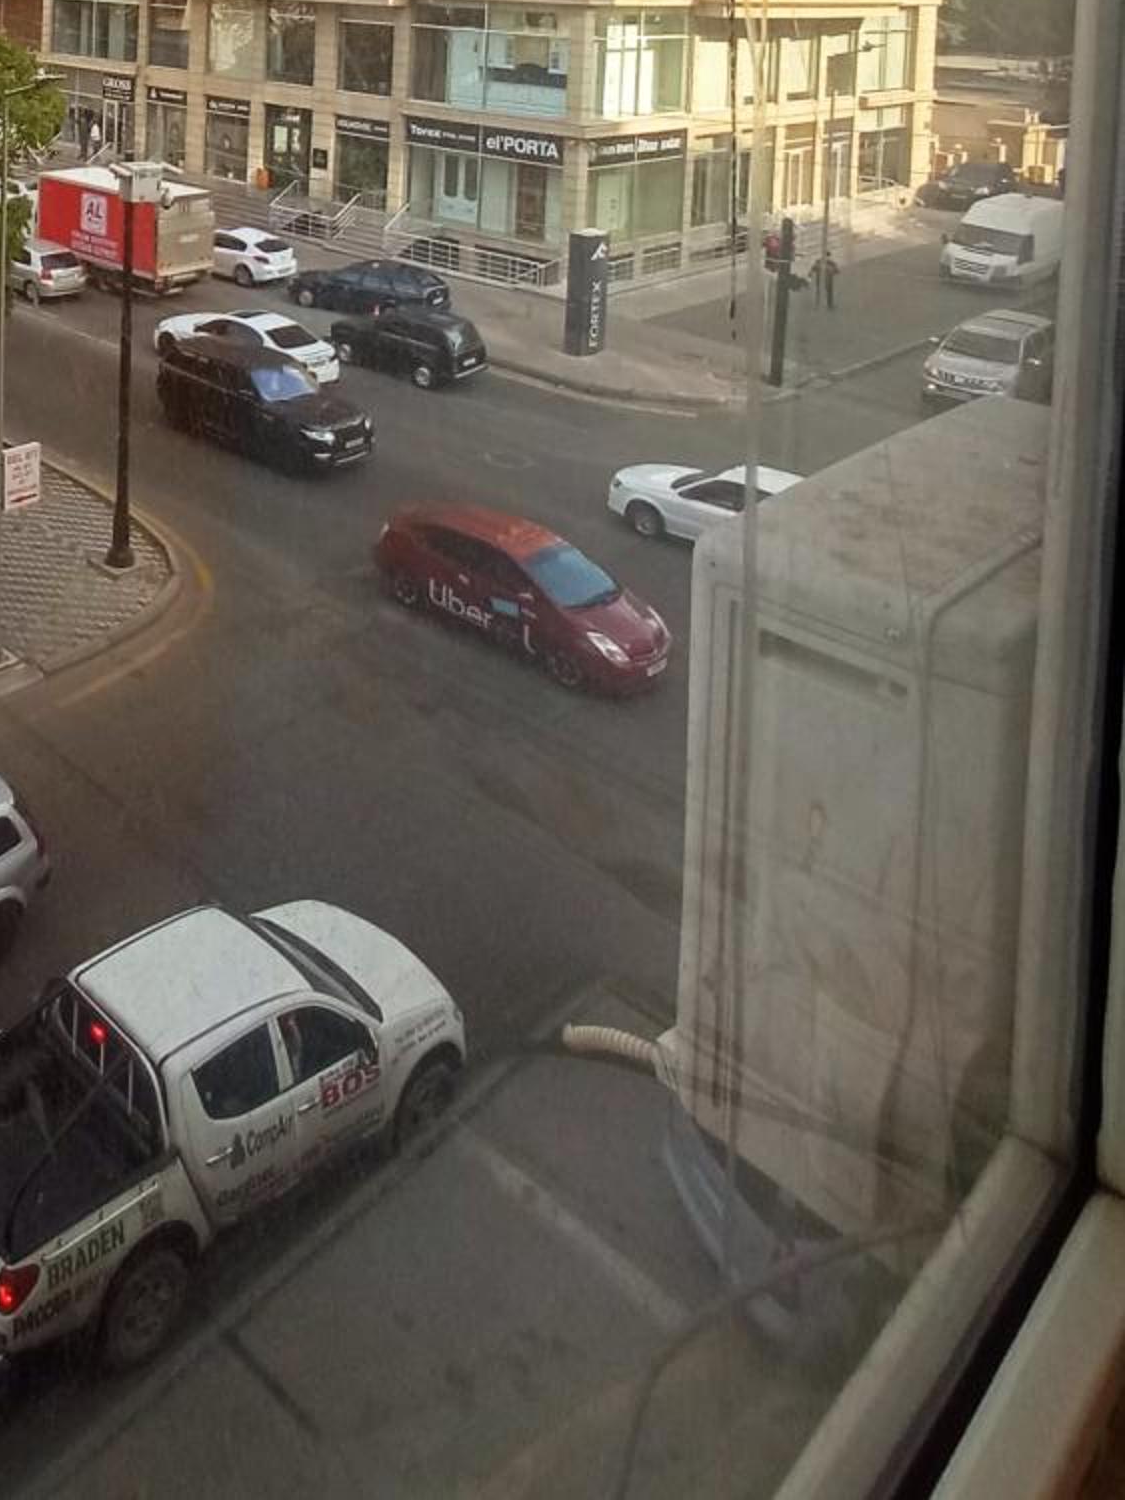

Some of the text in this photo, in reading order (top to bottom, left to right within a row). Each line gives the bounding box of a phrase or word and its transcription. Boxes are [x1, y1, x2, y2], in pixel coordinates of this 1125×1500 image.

[485, 133, 560, 159] el'PORTA
[428, 578, 493, 629] Uber
[47, 1219, 125, 1289] BRADEN
